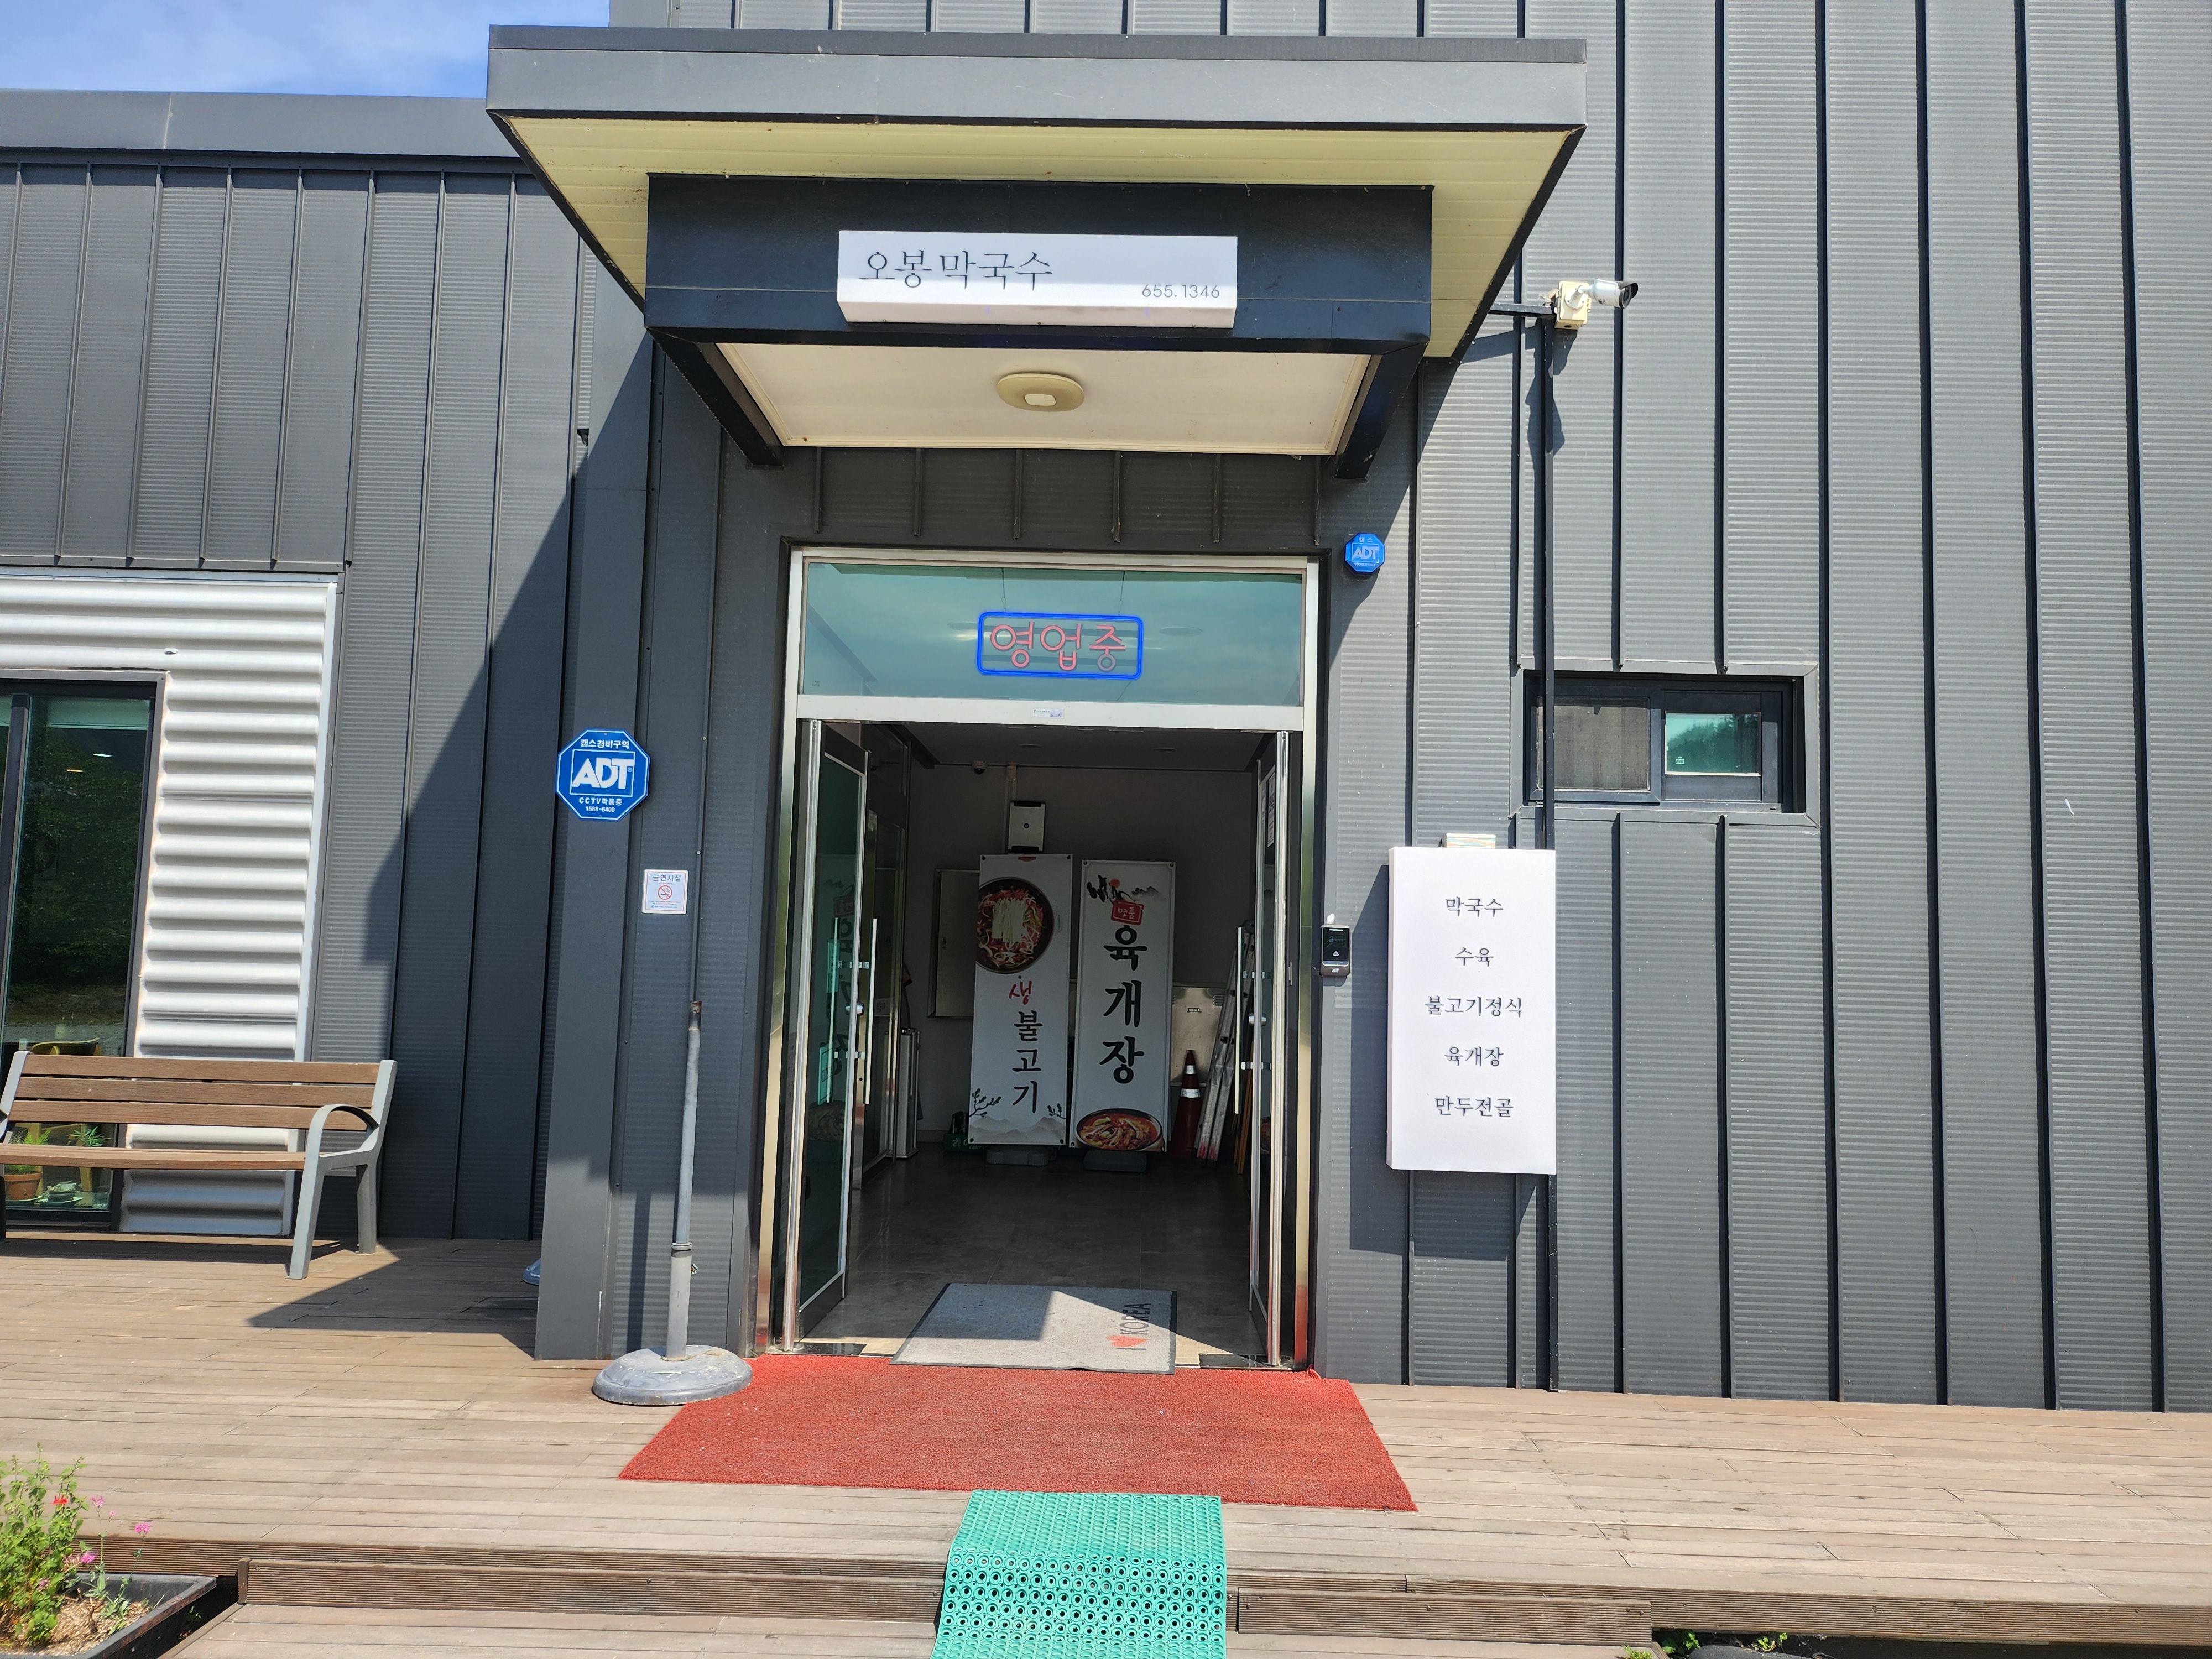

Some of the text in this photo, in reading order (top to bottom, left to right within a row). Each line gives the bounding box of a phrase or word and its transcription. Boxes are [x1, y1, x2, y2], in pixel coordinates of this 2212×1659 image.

[1141, 284, 1220, 299] 655.1346
[1352, 546, 1379, 560] ADT
[990, 620, 1126, 671] 영업중
[571, 757, 634, 789] ADT
[1445, 896, 1504, 917] 막국수
[1454, 947, 1494, 967] 수육
[1099, 925, 1147, 1084] 육개장
[1425, 995, 1522, 1018] 불고기정식
[1444, 1046, 1504, 1067] 육개장
[1434, 1095, 1514, 1118] 만두전골
[1119, 1303, 1151, 1335] KOREA
